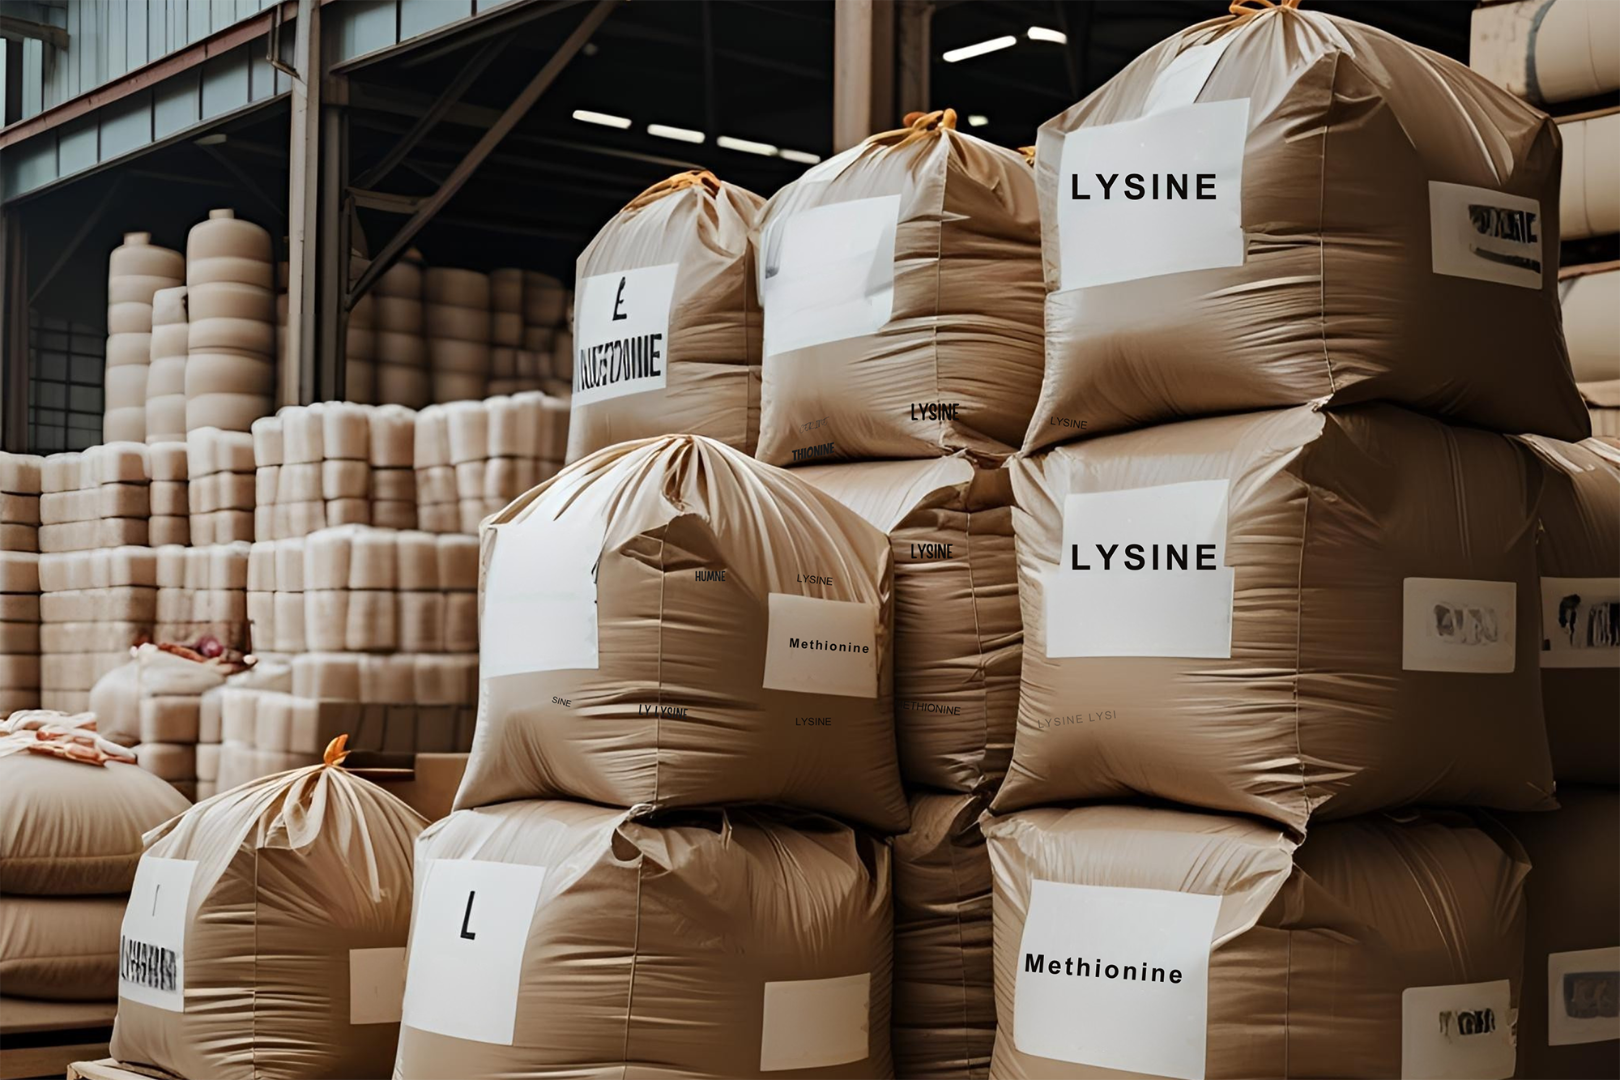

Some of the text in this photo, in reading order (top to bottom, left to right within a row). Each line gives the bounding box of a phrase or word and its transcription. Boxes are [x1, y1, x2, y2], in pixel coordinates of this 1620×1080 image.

[1071, 173, 1217, 201] LYSINE
[911, 403, 959, 421] LYSINE
[1050, 416, 1088, 430] LYSINE
[792, 442, 835, 463] THIONINE
[911, 543, 953, 559] LYSINE
[1071, 543, 1217, 571] LYSINE
[796, 573, 833, 586] LYSINE
[789, 637, 870, 654] Methionine
[551, 696, 572, 708] SINE
[654, 705, 689, 720] LYSINE
[795, 717, 832, 726] LYSINE
[1037, 715, 1084, 729] LYSINE
[460, 890, 476, 941] L
[1025, 953, 1183, 984] Methionine
